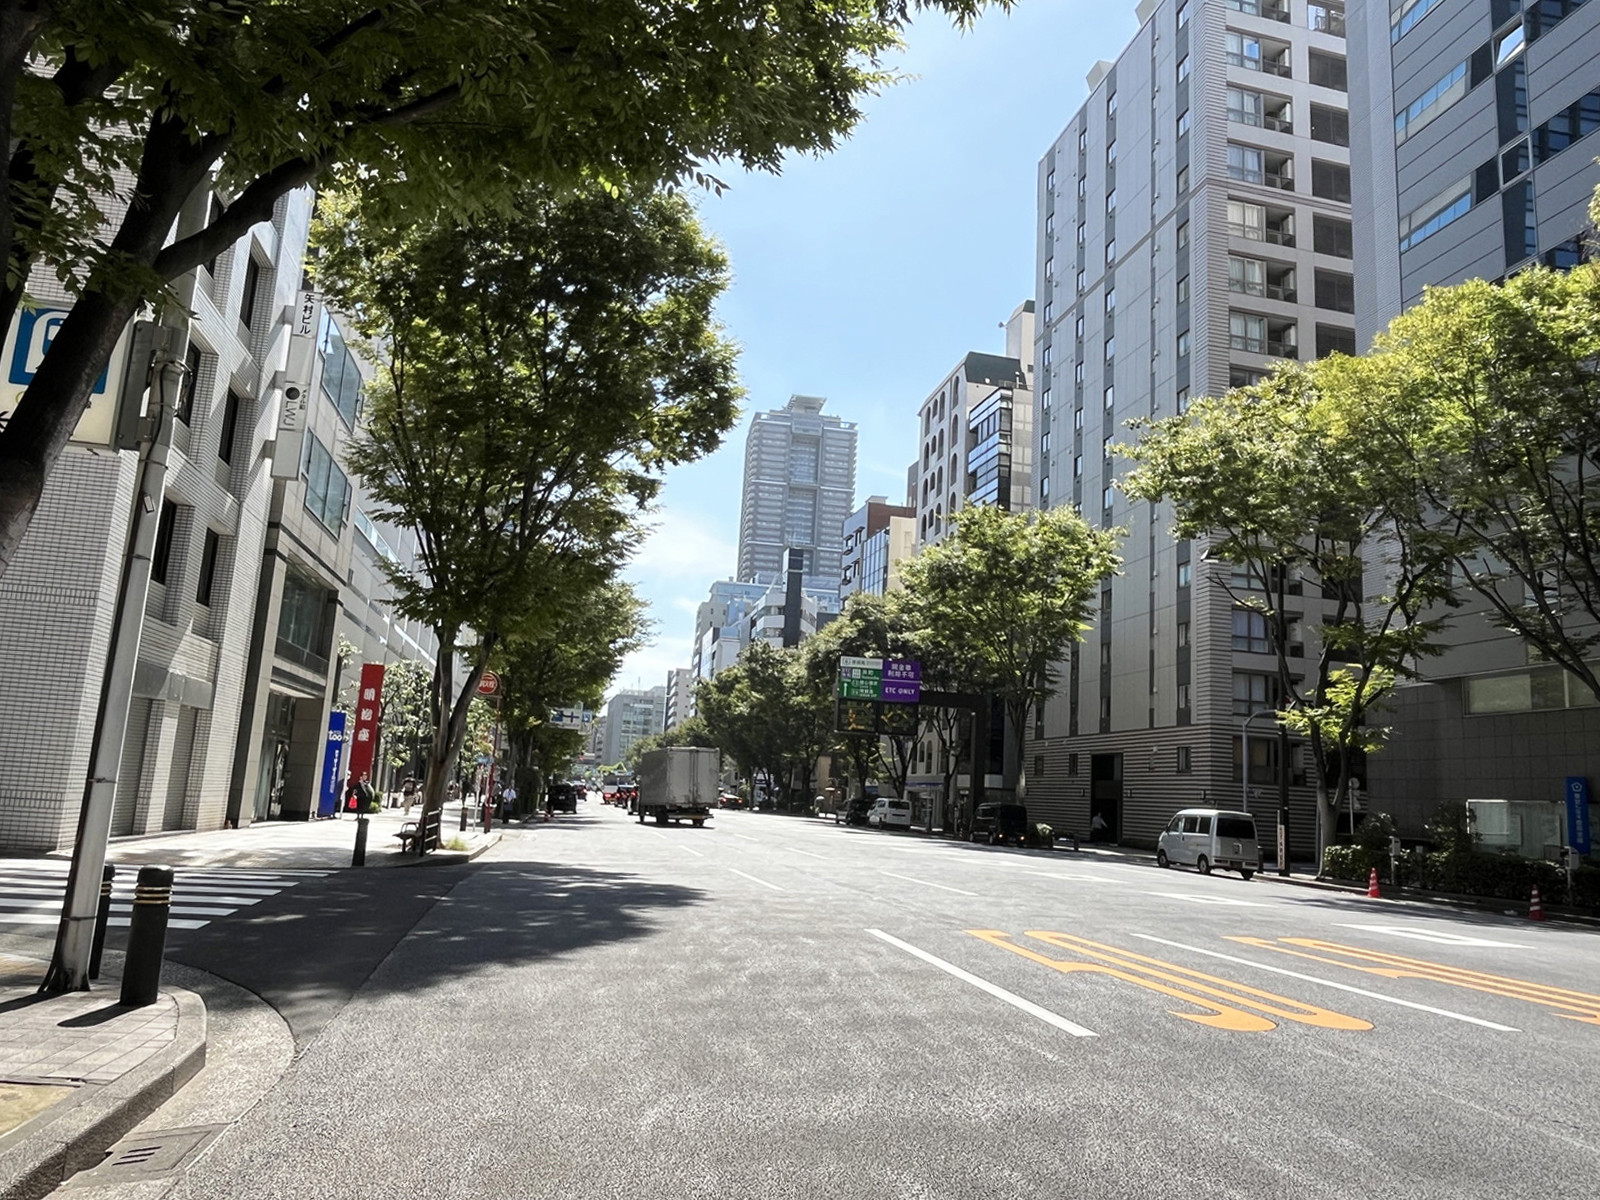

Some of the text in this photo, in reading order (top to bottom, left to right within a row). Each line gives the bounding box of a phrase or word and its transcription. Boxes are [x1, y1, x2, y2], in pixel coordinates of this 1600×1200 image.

[300, 293, 315, 334] 矢村ビル
[898, 687, 915, 695] ONLY
[357, 687, 376, 742] 明治座
